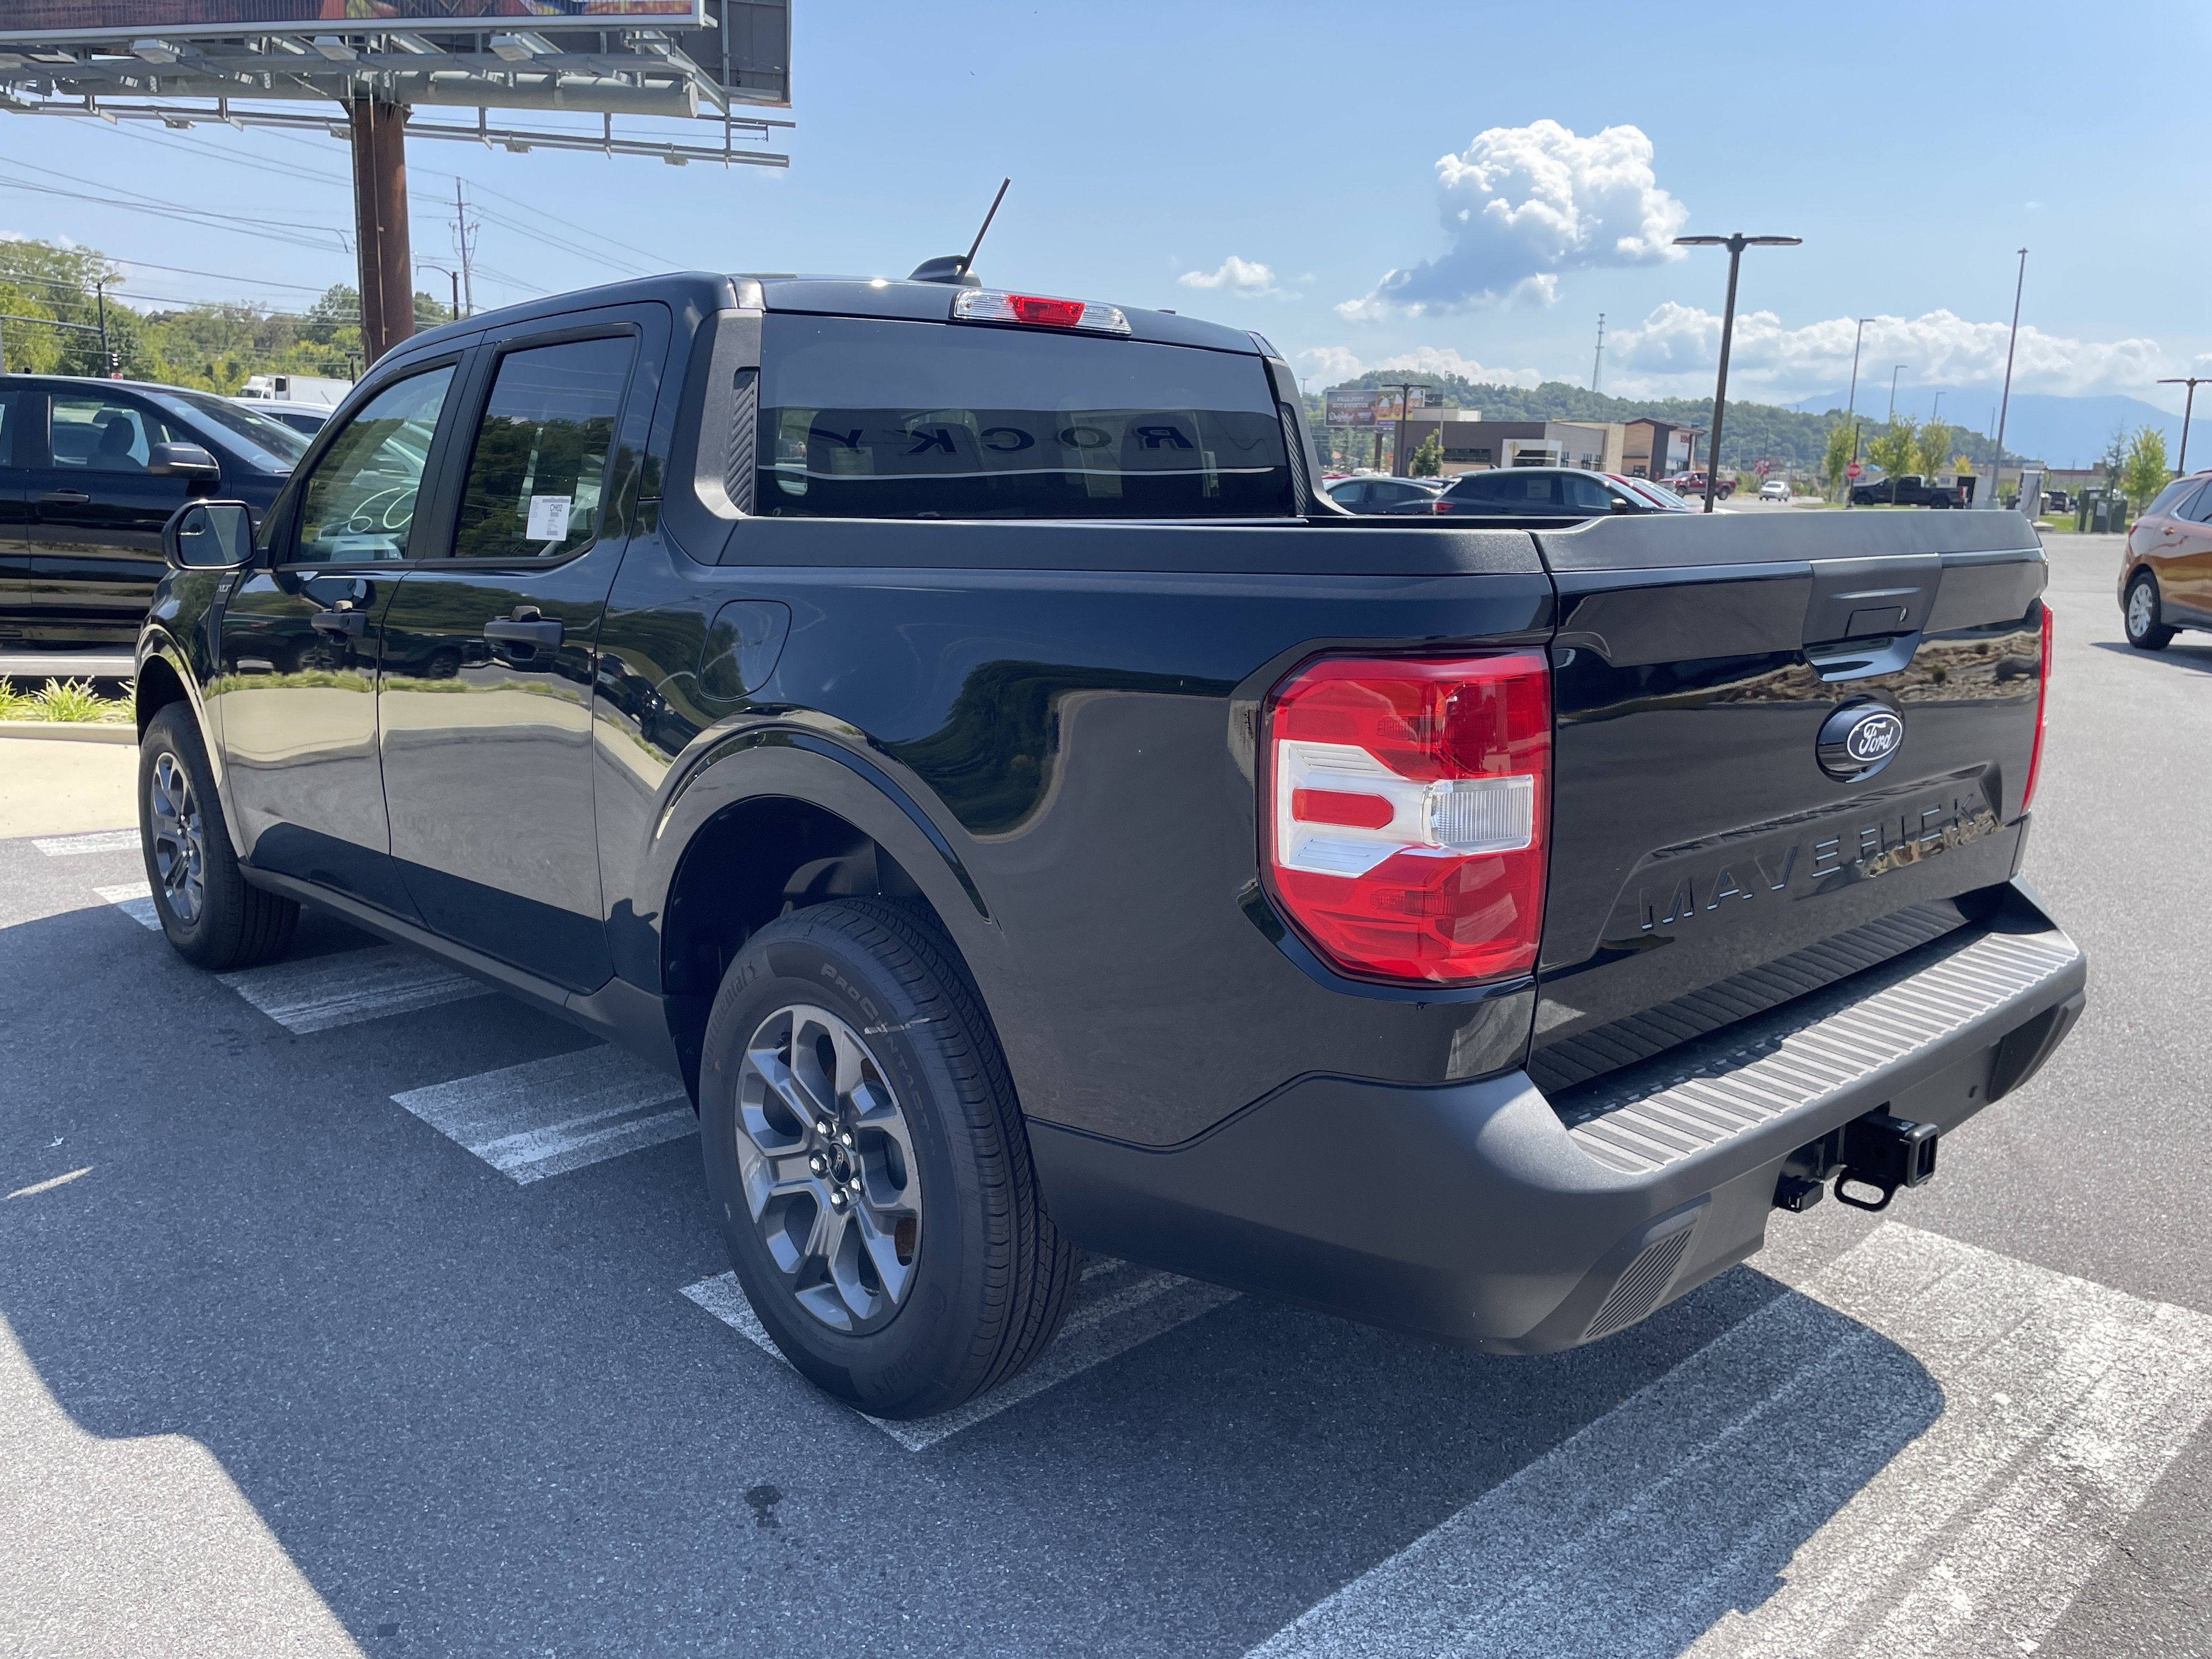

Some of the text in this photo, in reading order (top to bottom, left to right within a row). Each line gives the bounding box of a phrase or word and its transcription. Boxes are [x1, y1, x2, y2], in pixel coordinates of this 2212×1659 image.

[216, 584, 232, 592] XLT
[1859, 721, 1894, 755] Ford
[1639, 793, 1976, 930] MAVERICK
